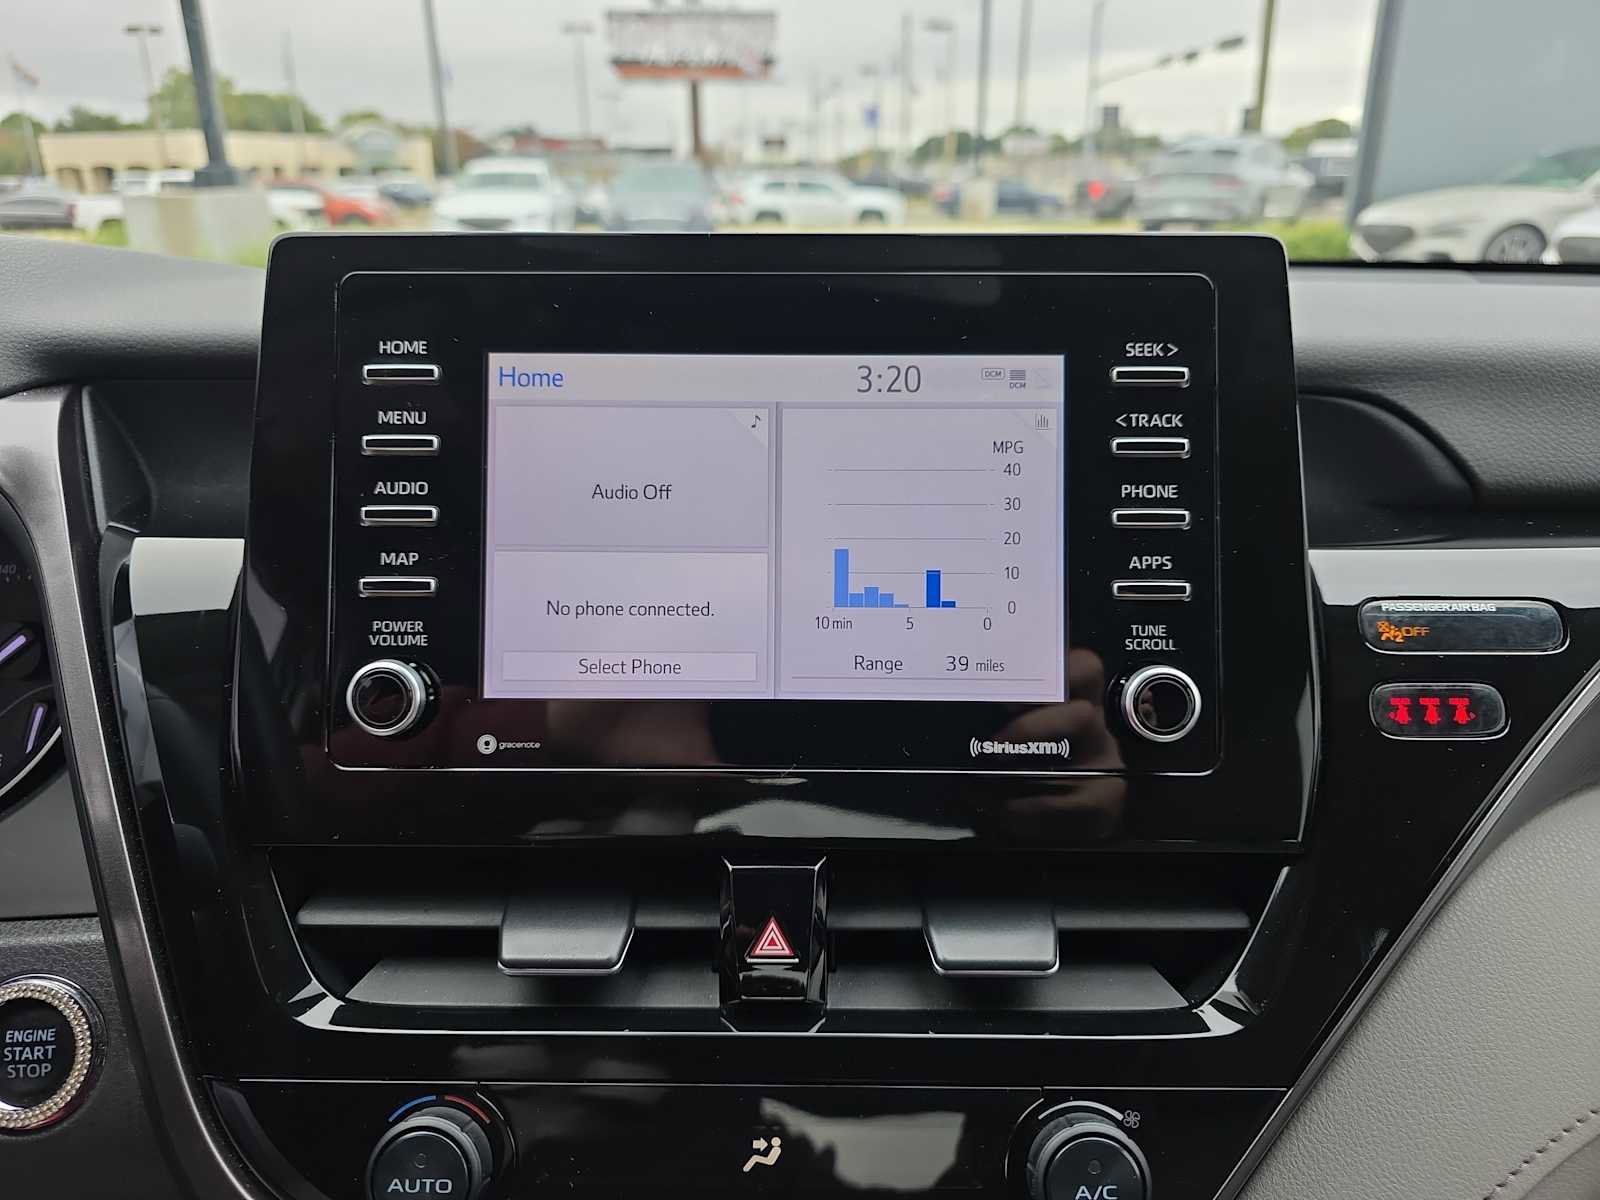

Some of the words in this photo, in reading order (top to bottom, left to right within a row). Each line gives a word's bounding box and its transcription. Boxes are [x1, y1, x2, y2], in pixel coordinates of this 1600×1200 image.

[379, 340, 428, 355] HOME
[499, 366, 564, 388] Home
[856, 364, 922, 393] 3:20
[1009, 381, 1027, 390] DCM
[377, 410, 427, 425] MENU
[992, 440, 1024, 454] MPG
[1002, 462, 1021, 477] 40
[373, 481, 429, 496] AUDIO
[591, 483, 639, 500] Audio
[643, 483, 673, 500] Off
[1121, 484, 1179, 499] PHONE
[1004, 496, 1021, 511] 30
[1003, 531, 1021, 545] 20
[380, 552, 419, 566] MAP
[1128, 555, 1173, 570] APPS
[1004, 566, 1020, 580] 10
[546, 599, 571, 616] No
[575, 600, 624, 620] phone
[628, 600, 715, 617] connected.
[1007, 600, 1017, 615] 0
[372, 620, 424, 633] POWER
[815, 615, 830, 630] 10
[832, 616, 853, 630] min
[905, 616, 914, 630] 5
[983, 617, 992, 631] 0
[1130, 624, 1167, 637] TUNE
[368, 634, 429, 647] VOLUME
[1124, 638, 1177, 651] SCROLL
[578, 658, 627, 675] Select
[631, 658, 682, 675] Phone
[854, 655, 903, 675] Range
[945, 655, 969, 672] 39
[975, 658, 1005, 672] miles
[5, 1028, 57, 1043] ENGINE
[3, 1044, 57, 1062] START
[7, 1063, 52, 1079] STOP
[387, 1178, 453, 1194] AUTO
[1074, 1185, 1119, 1200] A/C
